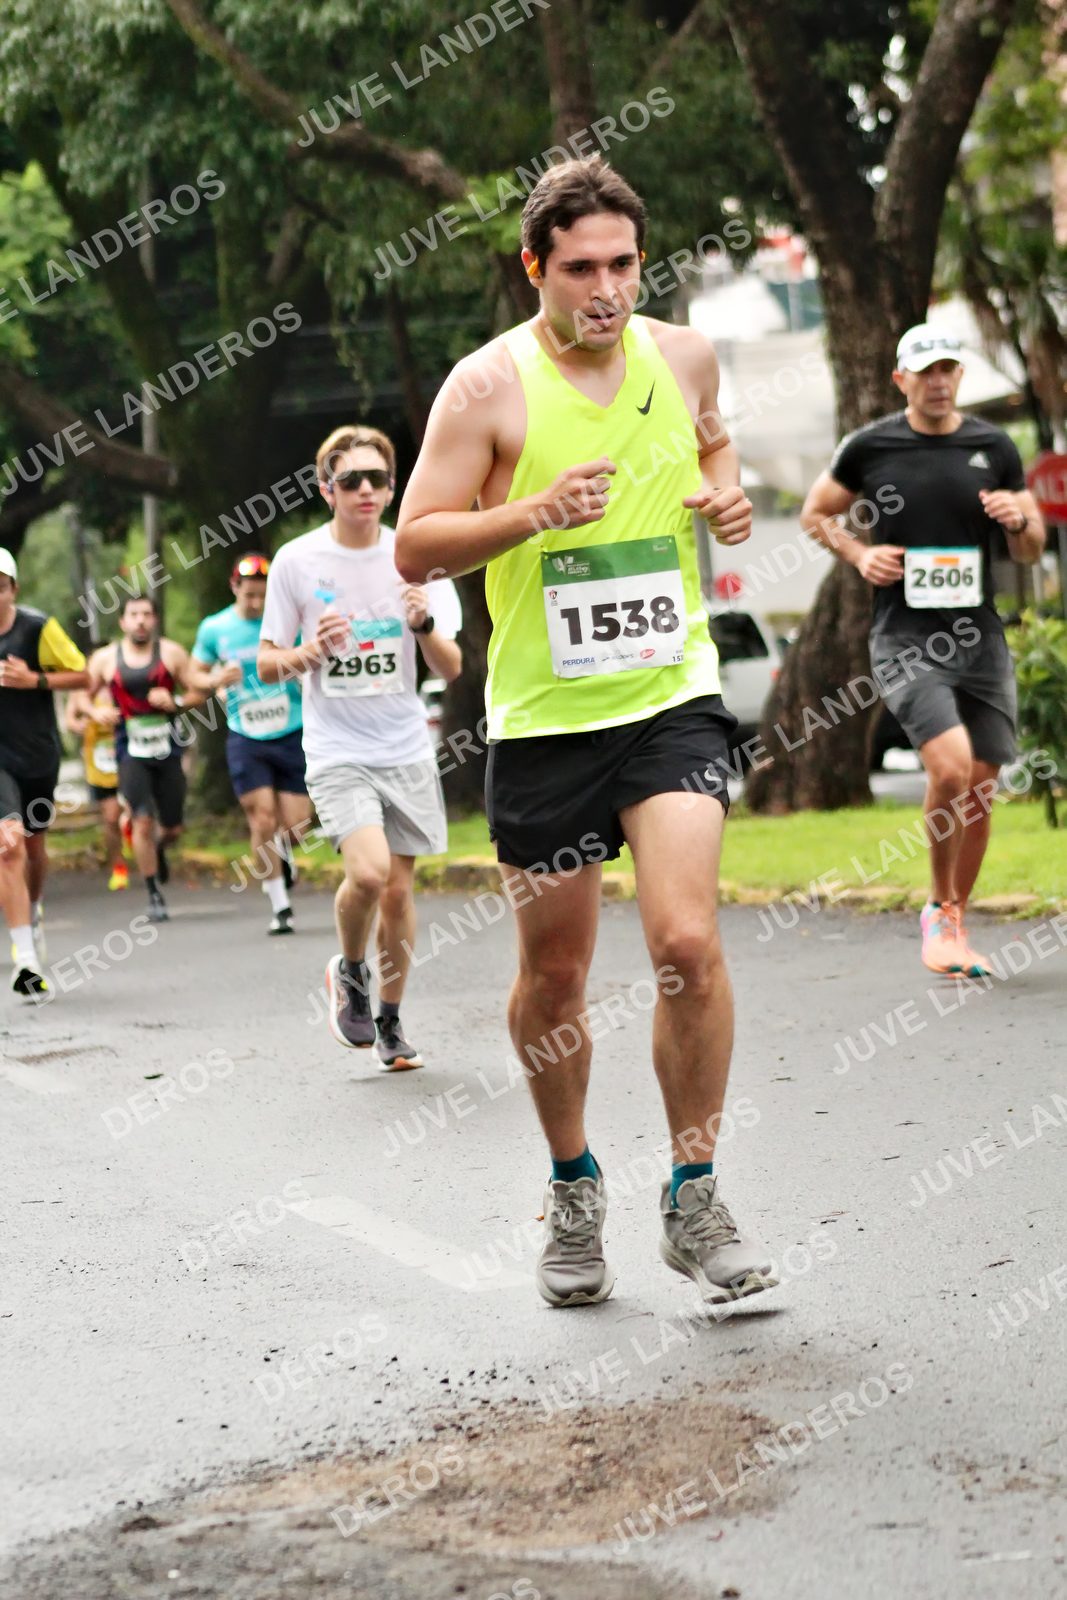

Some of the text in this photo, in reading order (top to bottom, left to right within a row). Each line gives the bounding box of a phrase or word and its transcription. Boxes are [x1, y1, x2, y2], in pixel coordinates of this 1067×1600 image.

[911, 567, 973, 588] 2606
[560, 596, 679, 646] 1538
[328, 653, 396, 677] 2963
[562, 656, 595, 666] PERDURA
